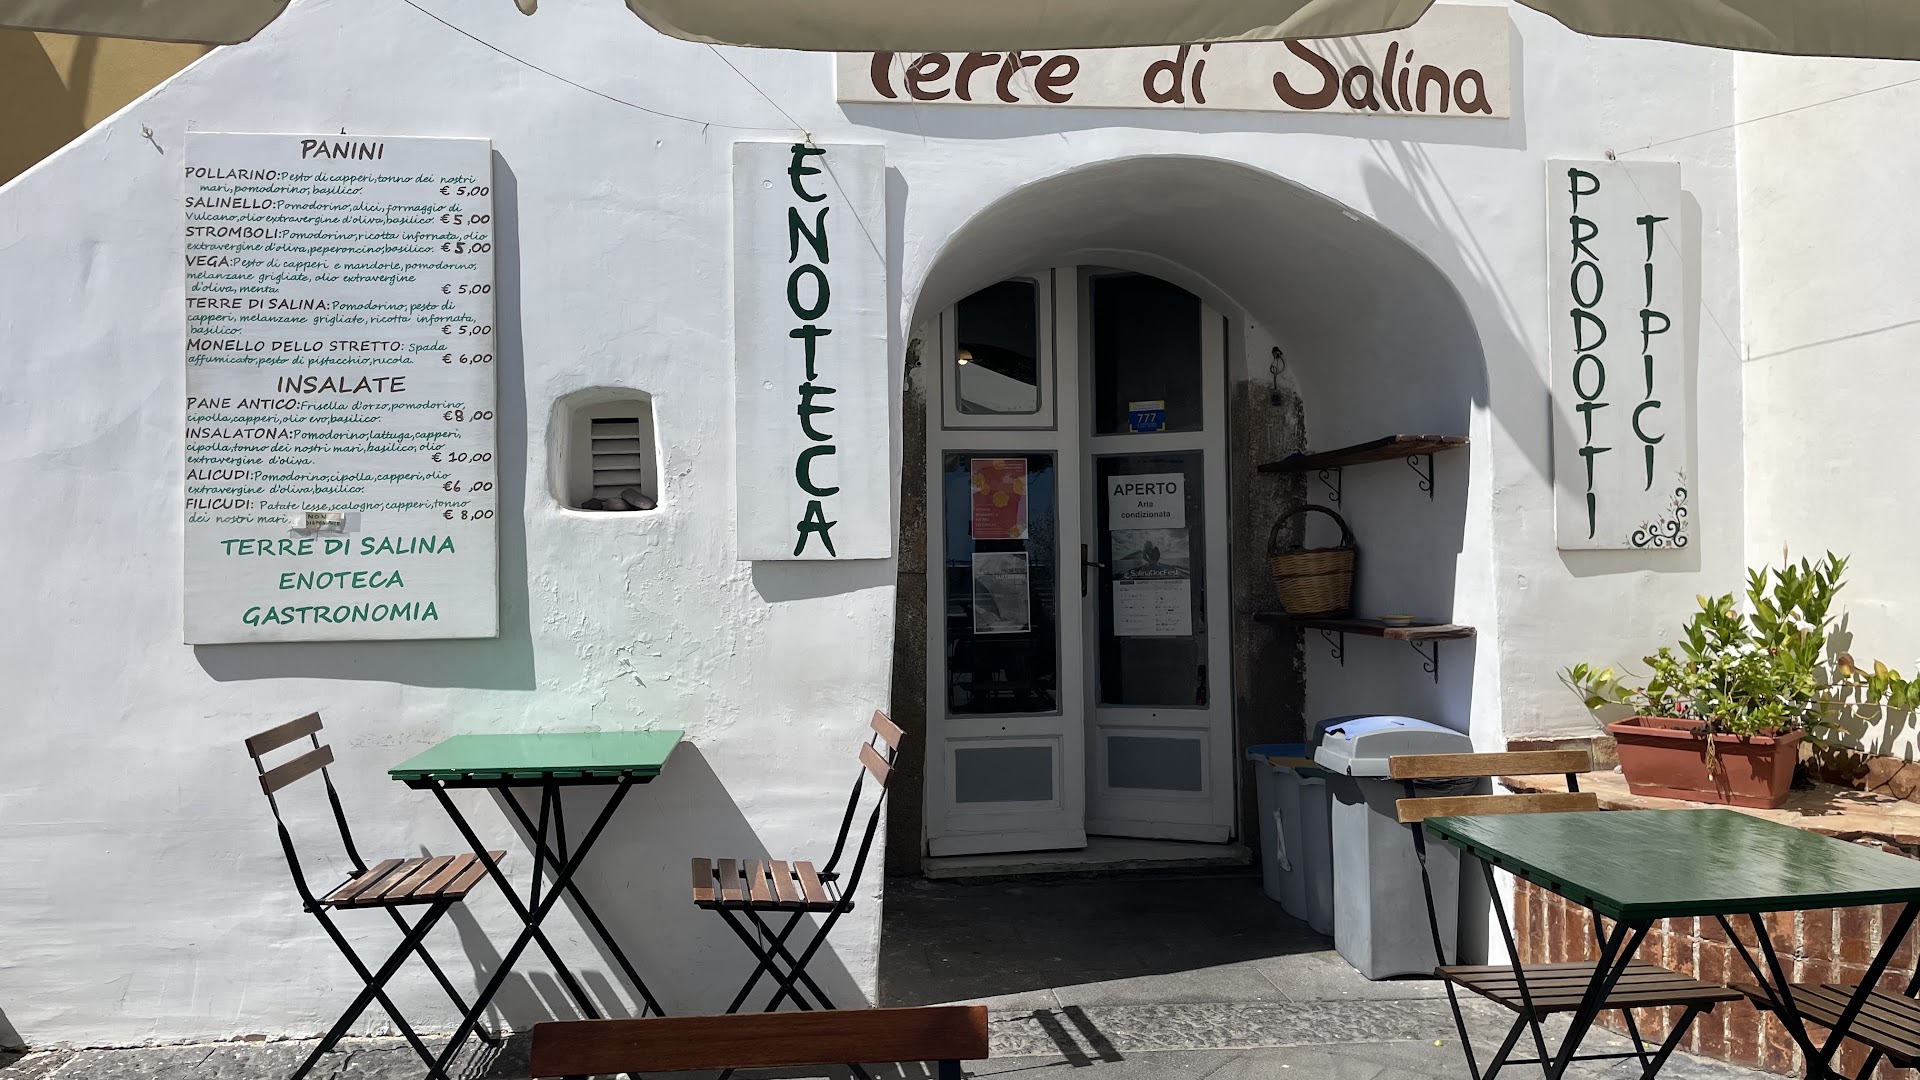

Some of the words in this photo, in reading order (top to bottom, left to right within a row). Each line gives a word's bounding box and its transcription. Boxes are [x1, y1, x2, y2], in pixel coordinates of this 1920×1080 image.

[1143, 44, 1211, 104] di
[1273, 41, 1493, 115] Salina
[301, 139, 385, 161] PANINI
[414, 173, 434, 183] dei
[438, 174, 476, 185] nostri
[447, 202, 464, 213] di
[264, 211, 341, 227] extravergine
[186, 240, 264, 254] extravergine
[265, 257, 281, 269] di
[281, 258, 329, 272] capperi
[332, 262, 342, 270] e
[185, 269, 256, 281] melanzane
[313, 272, 340, 283] olio
[342, 272, 416, 286] extravergine
[184, 296, 243, 310] TERRE
[247, 297, 264, 310] DI
[409, 301, 440, 315] pesto
[440, 298, 456, 312] di
[238, 312, 309, 324] melanzane
[370, 313, 411, 324] ricotta
[185, 337, 266, 352] MONELLO
[270, 338, 324, 353] DELLO
[787, 143, 839, 557] ENOTECA
[290, 354, 305, 365] di
[1568, 167, 1612, 540] PRODOTTI
[1632, 214, 1671, 491] TIPICI
[276, 373, 406, 394] INSALATE
[185, 396, 232, 410] PANE
[1137, 413, 1156, 423] 777
[269, 441, 292, 452] dei
[293, 441, 332, 454] nostri
[418, 441, 446, 451] olio
[186, 454, 264, 467] extravergine
[187, 483, 265, 497] extravergine
[1113, 482, 1177, 496] APERTO
[258, 499, 300, 511] Patate
[1137, 500, 1154, 508] Aria
[186, 510, 211, 524] dei
[214, 511, 254, 524] nostri
[1121, 510, 1171, 519] condizionata
[220, 533, 316, 556] TERRE
[324, 533, 350, 555] DI
[360, 535, 455, 555] SALINA
[278, 570, 404, 589] ENOTECA
[242, 602, 438, 625] GASTRONOMIA
